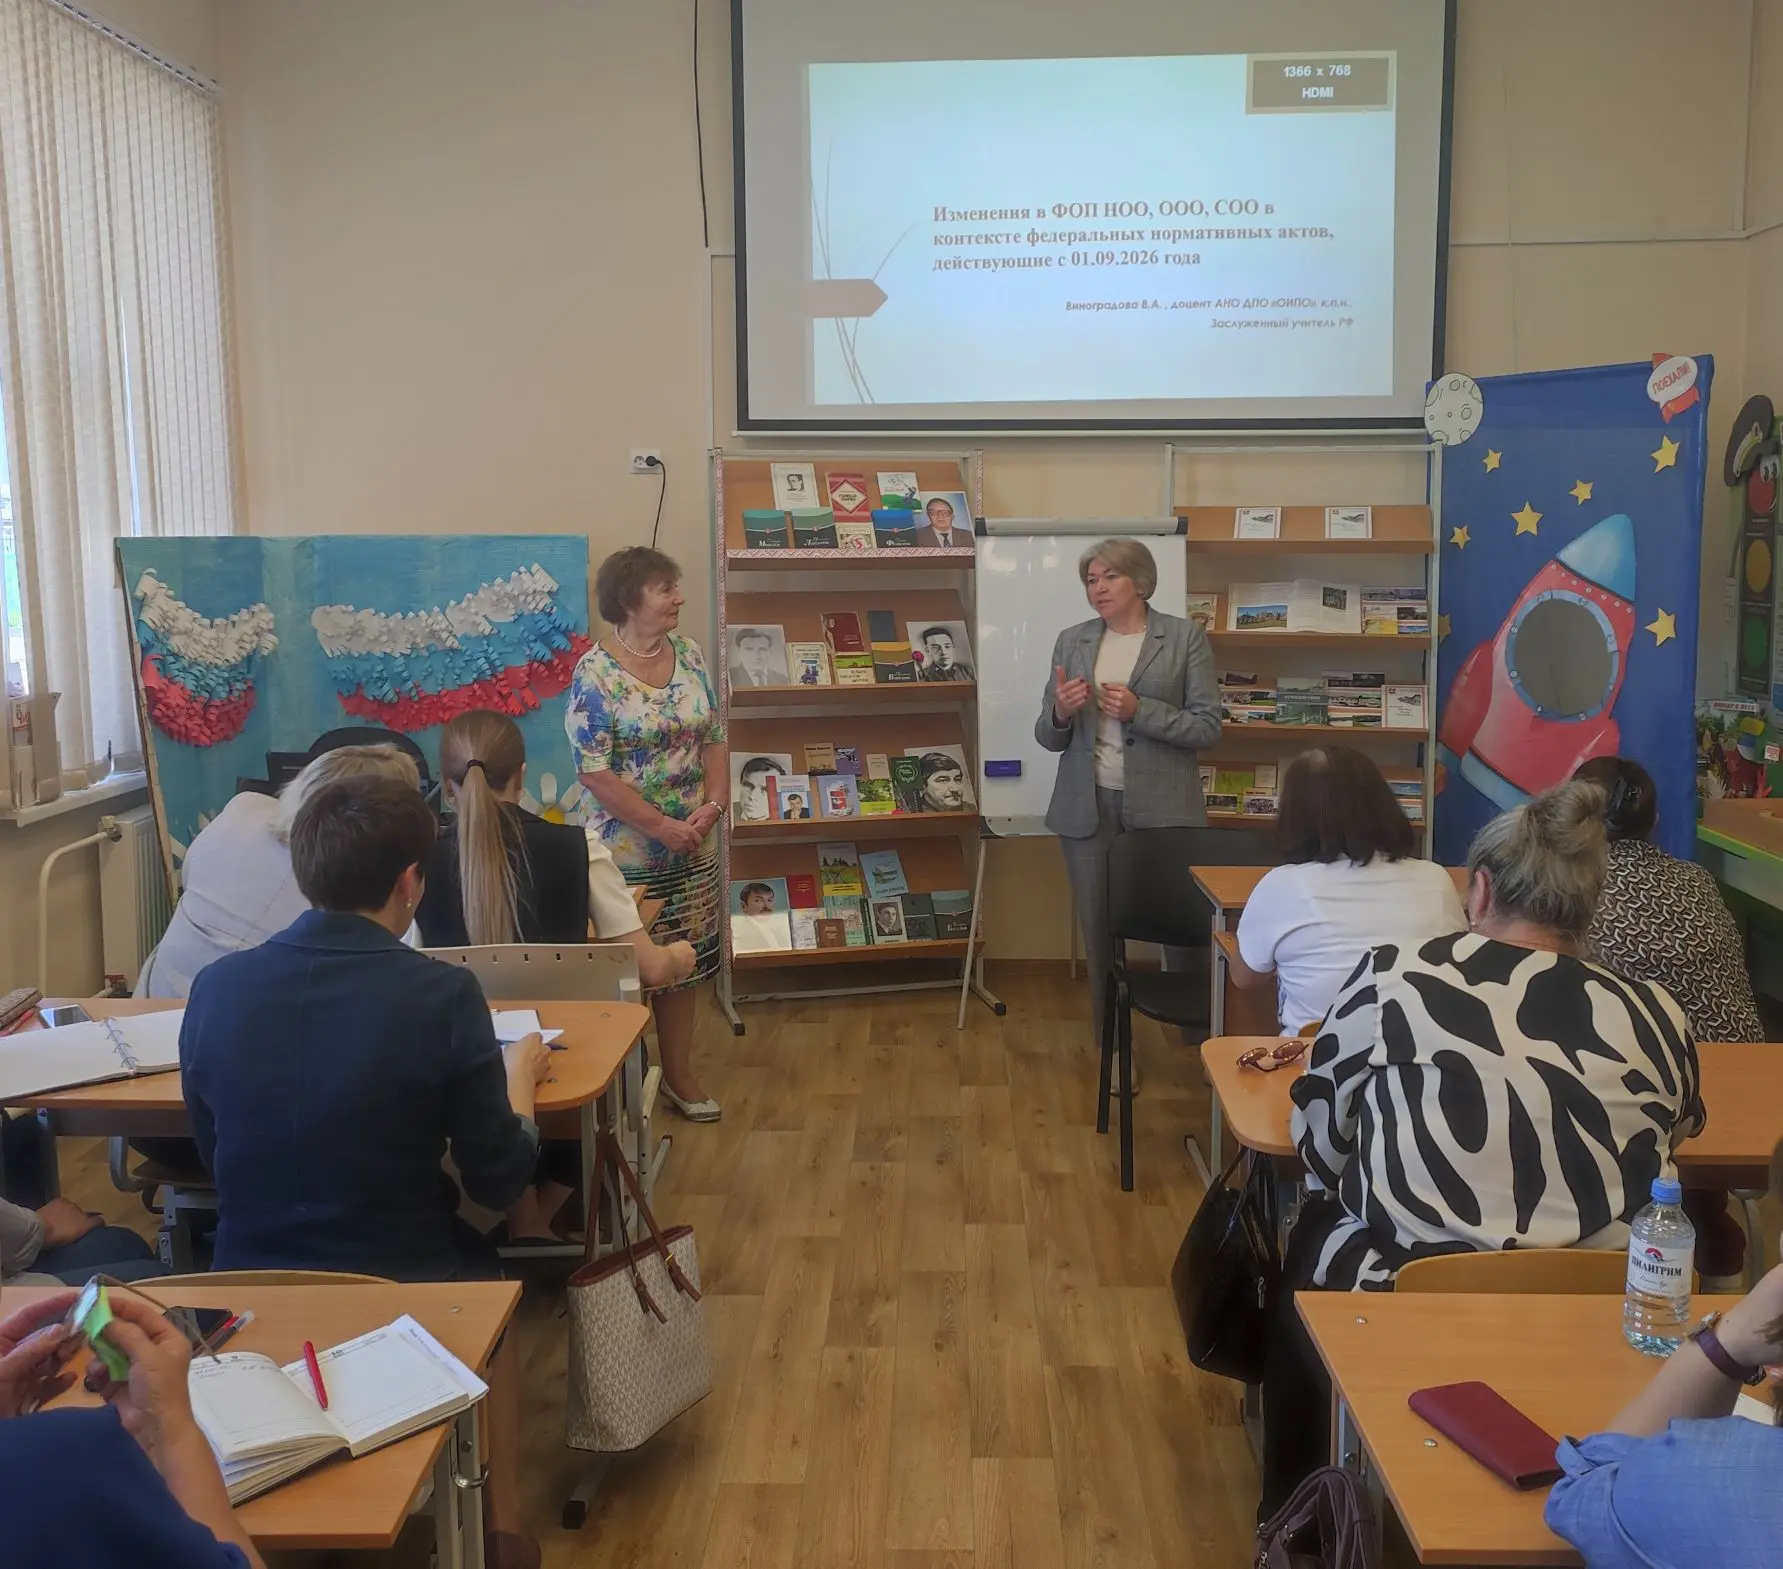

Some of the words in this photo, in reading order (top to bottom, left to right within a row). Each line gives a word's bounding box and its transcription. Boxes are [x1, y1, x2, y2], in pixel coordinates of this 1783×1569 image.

[1283, 65, 1311, 77] 1366
[1328, 64, 1352, 76] 768
[1302, 86, 1334, 98] HDMI
[933, 206, 1030, 222] Изменения
[1036, 208, 1046, 219] в
[1052, 202, 1098, 218] ФОП
[1104, 200, 1153, 219] НОО,
[1159, 199, 1209, 217] ООО,
[1214, 198, 1259, 216] СОО
[1264, 203, 1274, 215] в
[933, 231, 1022, 246] контексте
[1026, 228, 1144, 246] федеральных
[1150, 227, 1272, 244] нормативных
[1278, 226, 1334, 241] актов,
[933, 255, 1053, 272] действующие
[1058, 255, 1067, 267] с
[1071, 250, 1159, 266] 01.09.2026
[1164, 252, 1201, 266] года
[1065, 300, 1139, 312] Виноградова
[1170, 299, 1211, 310] доцент
[1214, 297, 1240, 308] АНО
[1242, 297, 1269, 309] ДПО
[1210, 317, 1289, 330] Заслуженный
[1291, 318, 1336, 330] учитель
[1338, 316, 1355, 328] РФ
